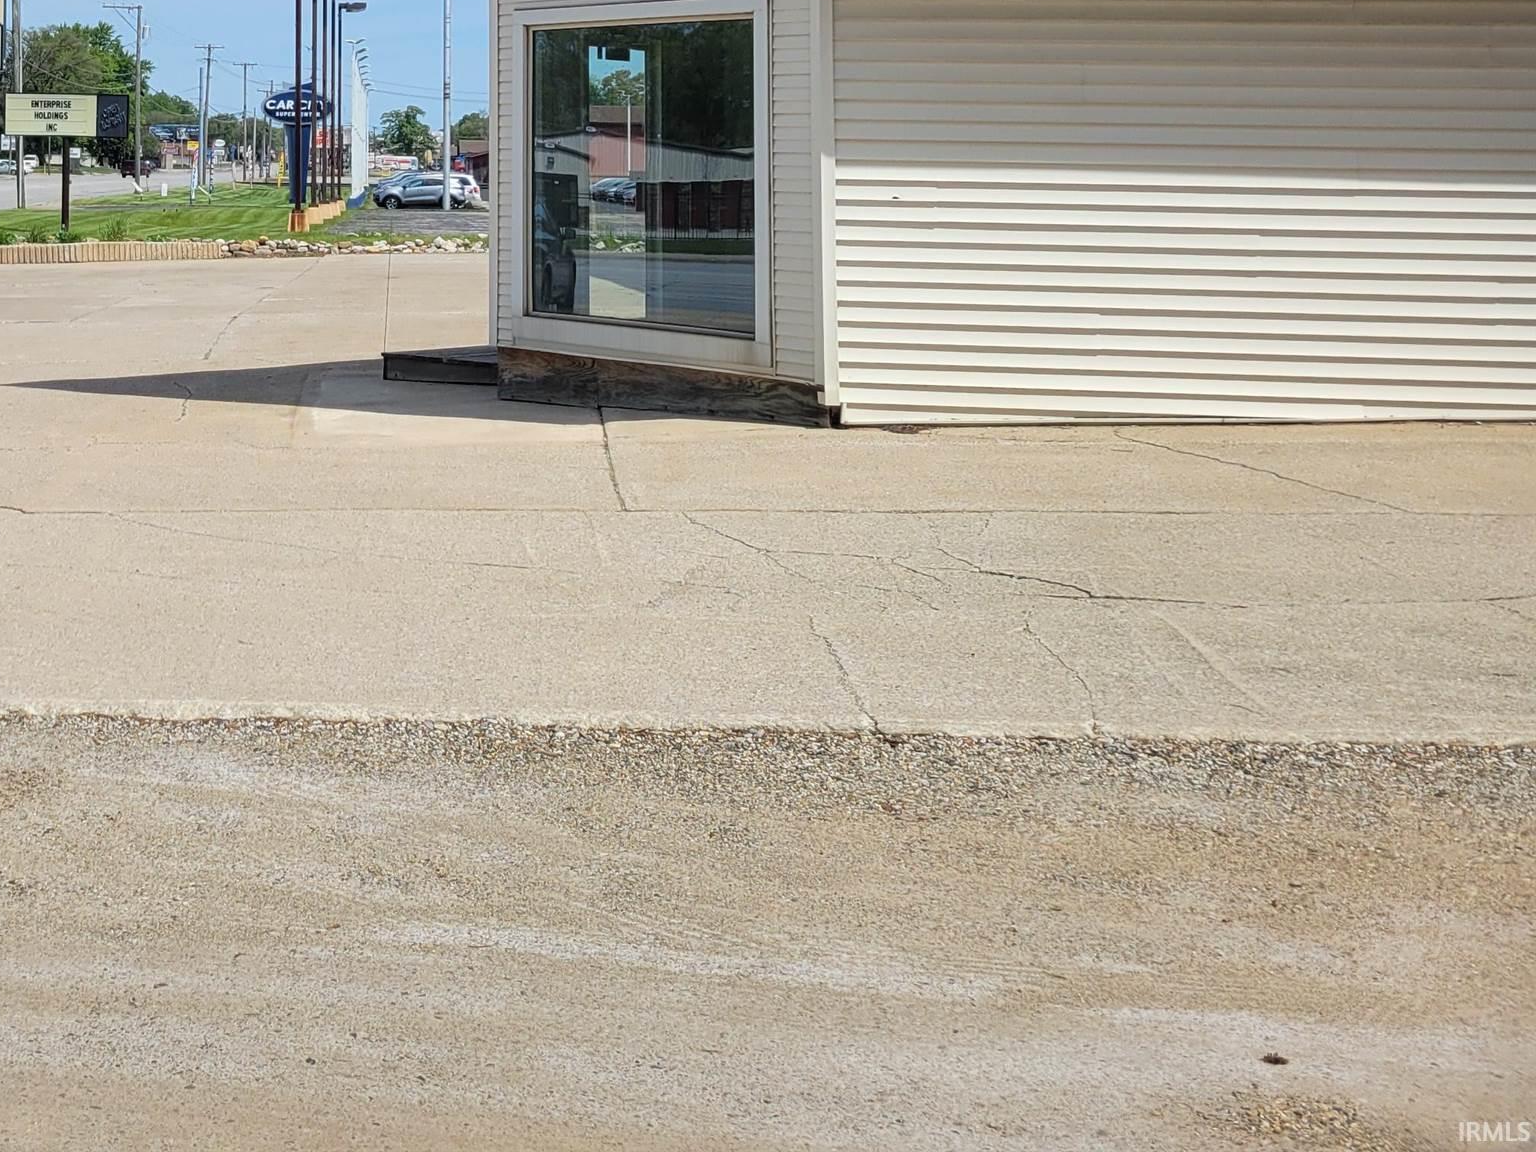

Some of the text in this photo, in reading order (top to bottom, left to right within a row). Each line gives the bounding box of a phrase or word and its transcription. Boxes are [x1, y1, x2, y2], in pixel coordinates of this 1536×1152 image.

[30, 100, 72, 109] ENTERPRISE
[265, 99, 294, 110] CAR
[34, 111, 69, 120] HOLDINGS
[45, 123, 58, 132] INC
